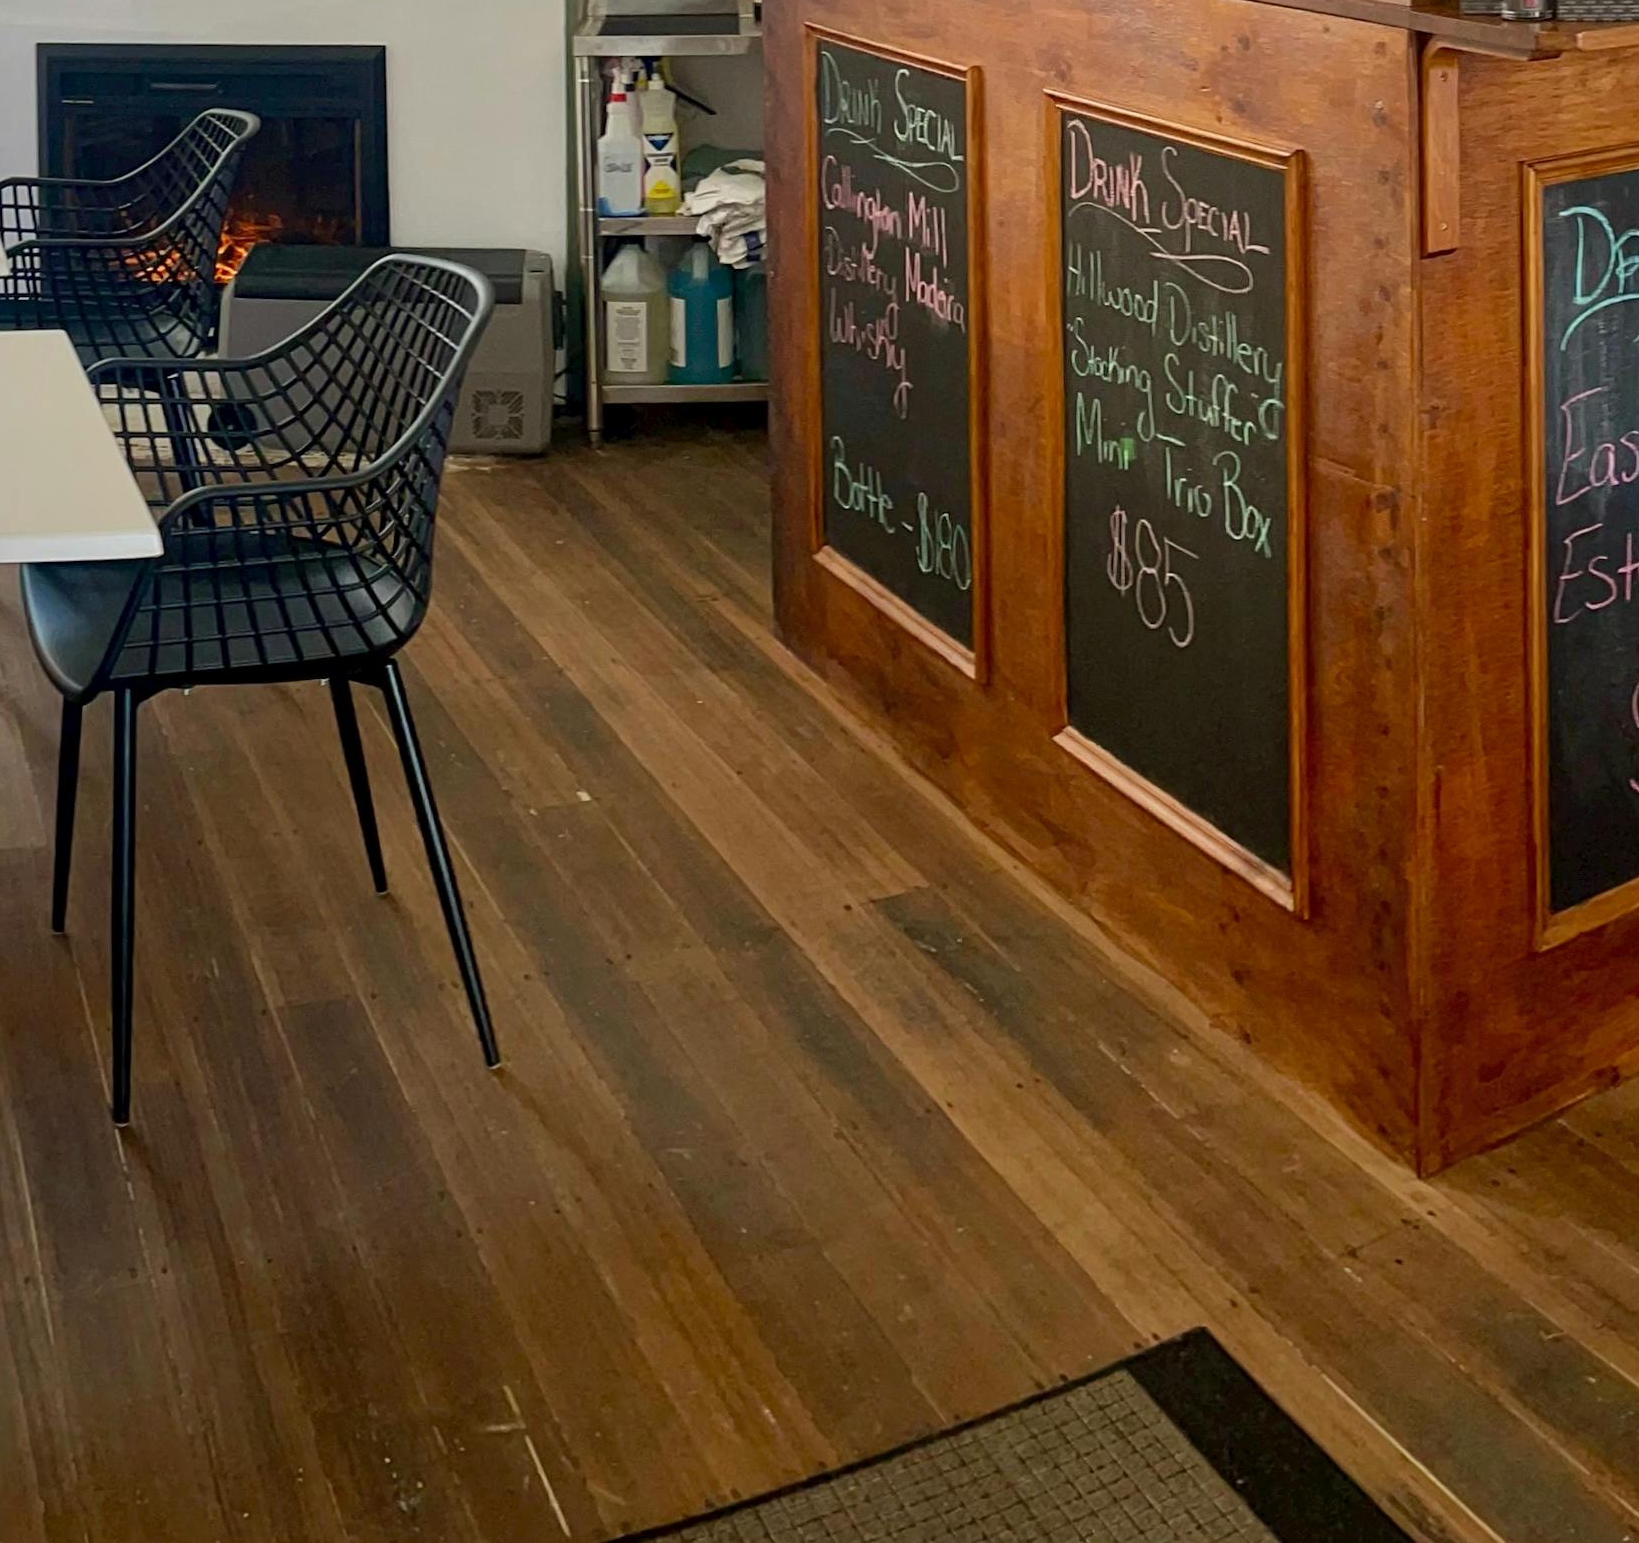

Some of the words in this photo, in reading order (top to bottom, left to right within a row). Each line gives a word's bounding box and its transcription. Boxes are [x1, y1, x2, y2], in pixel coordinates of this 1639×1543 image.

[893, 68, 964, 162] SPECIAL
[908, 191, 948, 269] Mill
[1066, 118, 1151, 225] DRINK
[1161, 146, 1271, 256] SPECIAL
[1163, 281, 1286, 441] Distillery
[1211, 449, 1274, 559] Box
[1106, 505, 1199, 649] $85
